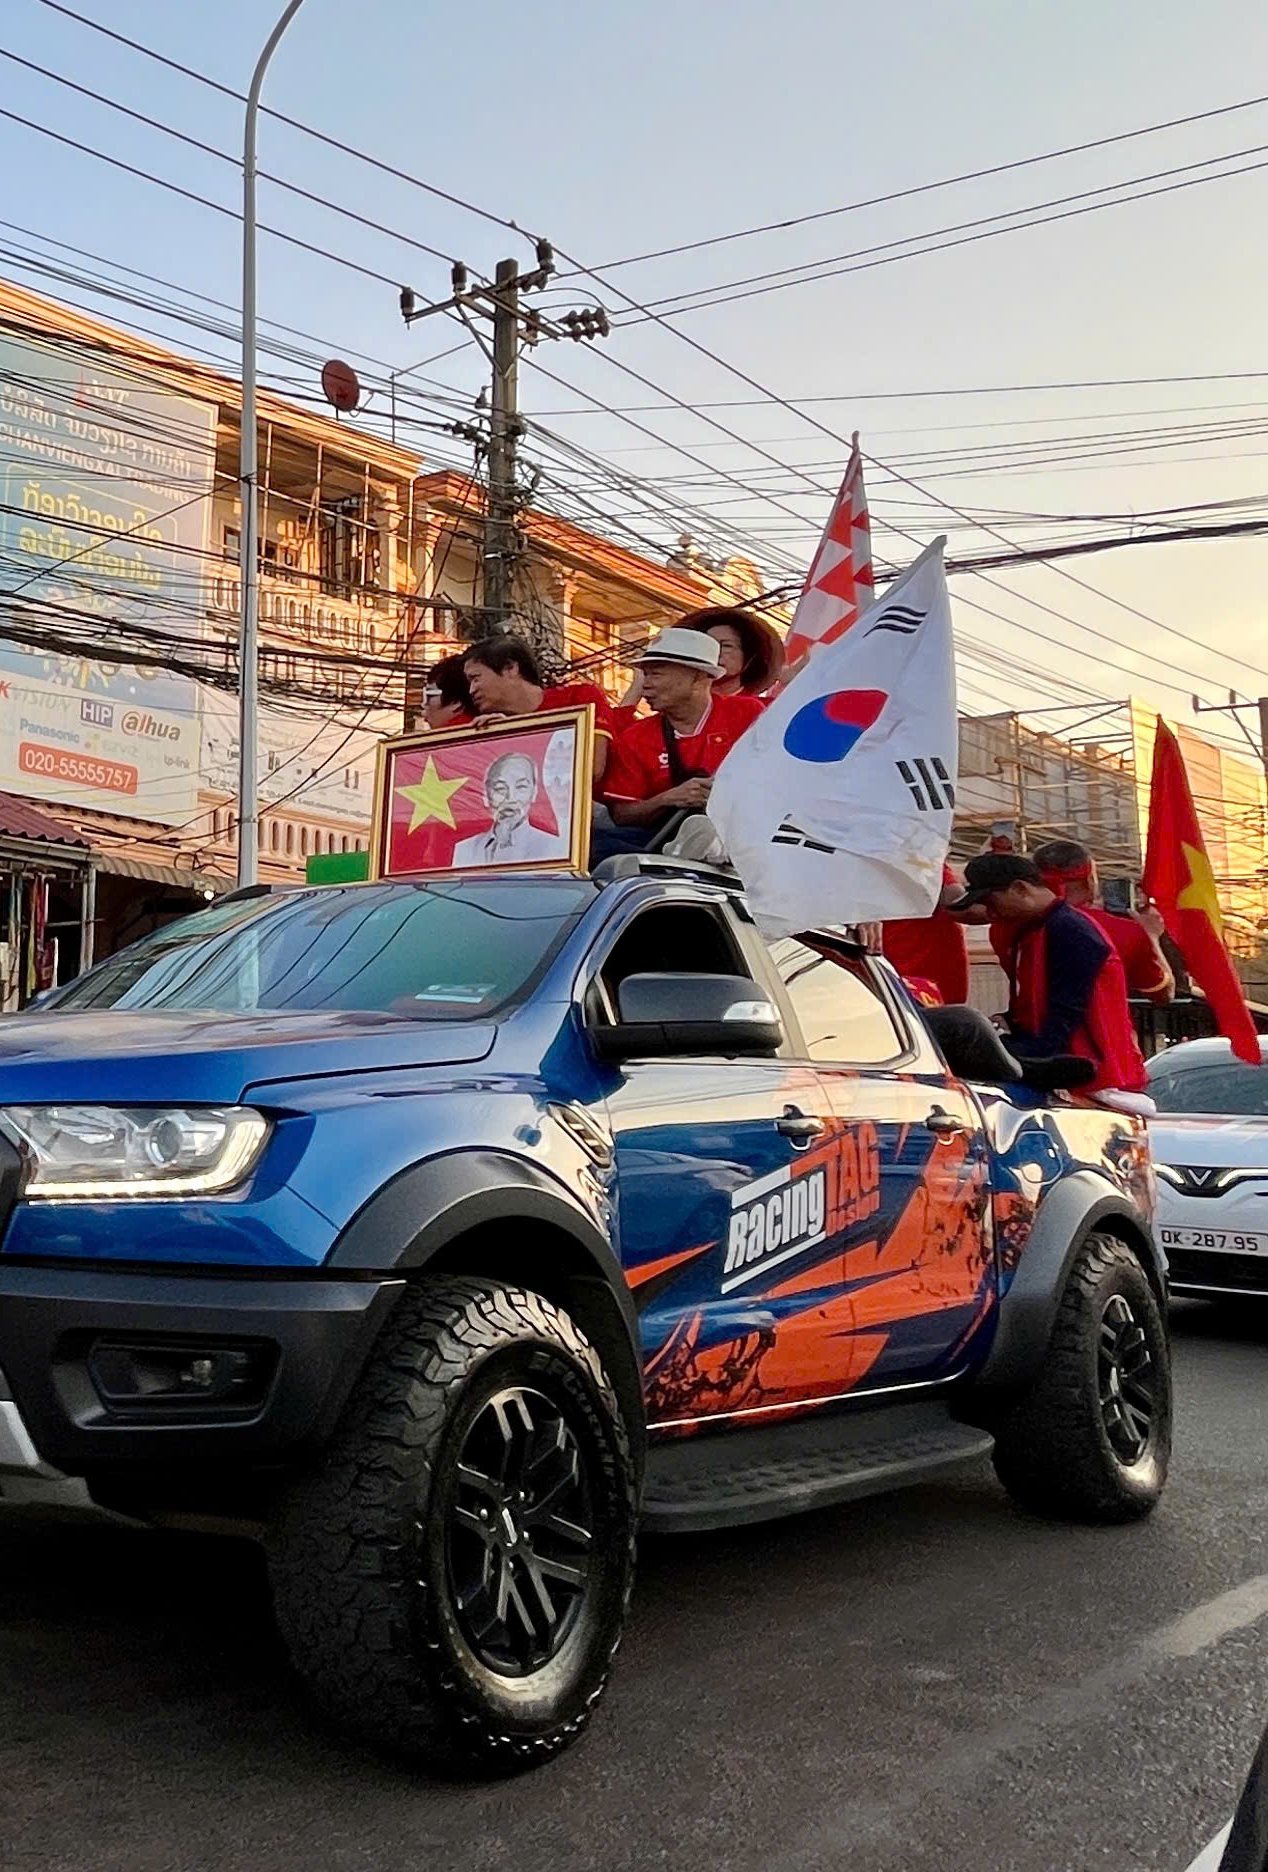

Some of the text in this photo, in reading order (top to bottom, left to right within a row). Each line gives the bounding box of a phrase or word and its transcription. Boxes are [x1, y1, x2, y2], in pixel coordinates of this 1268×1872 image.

[19, 718, 80, 744] Panasonic
[82, 701, 112, 724] HIP
[25, 749, 132, 789] 020-55555757
[792, 1120, 880, 1212] TAG
[723, 1171, 825, 1274] Racing
